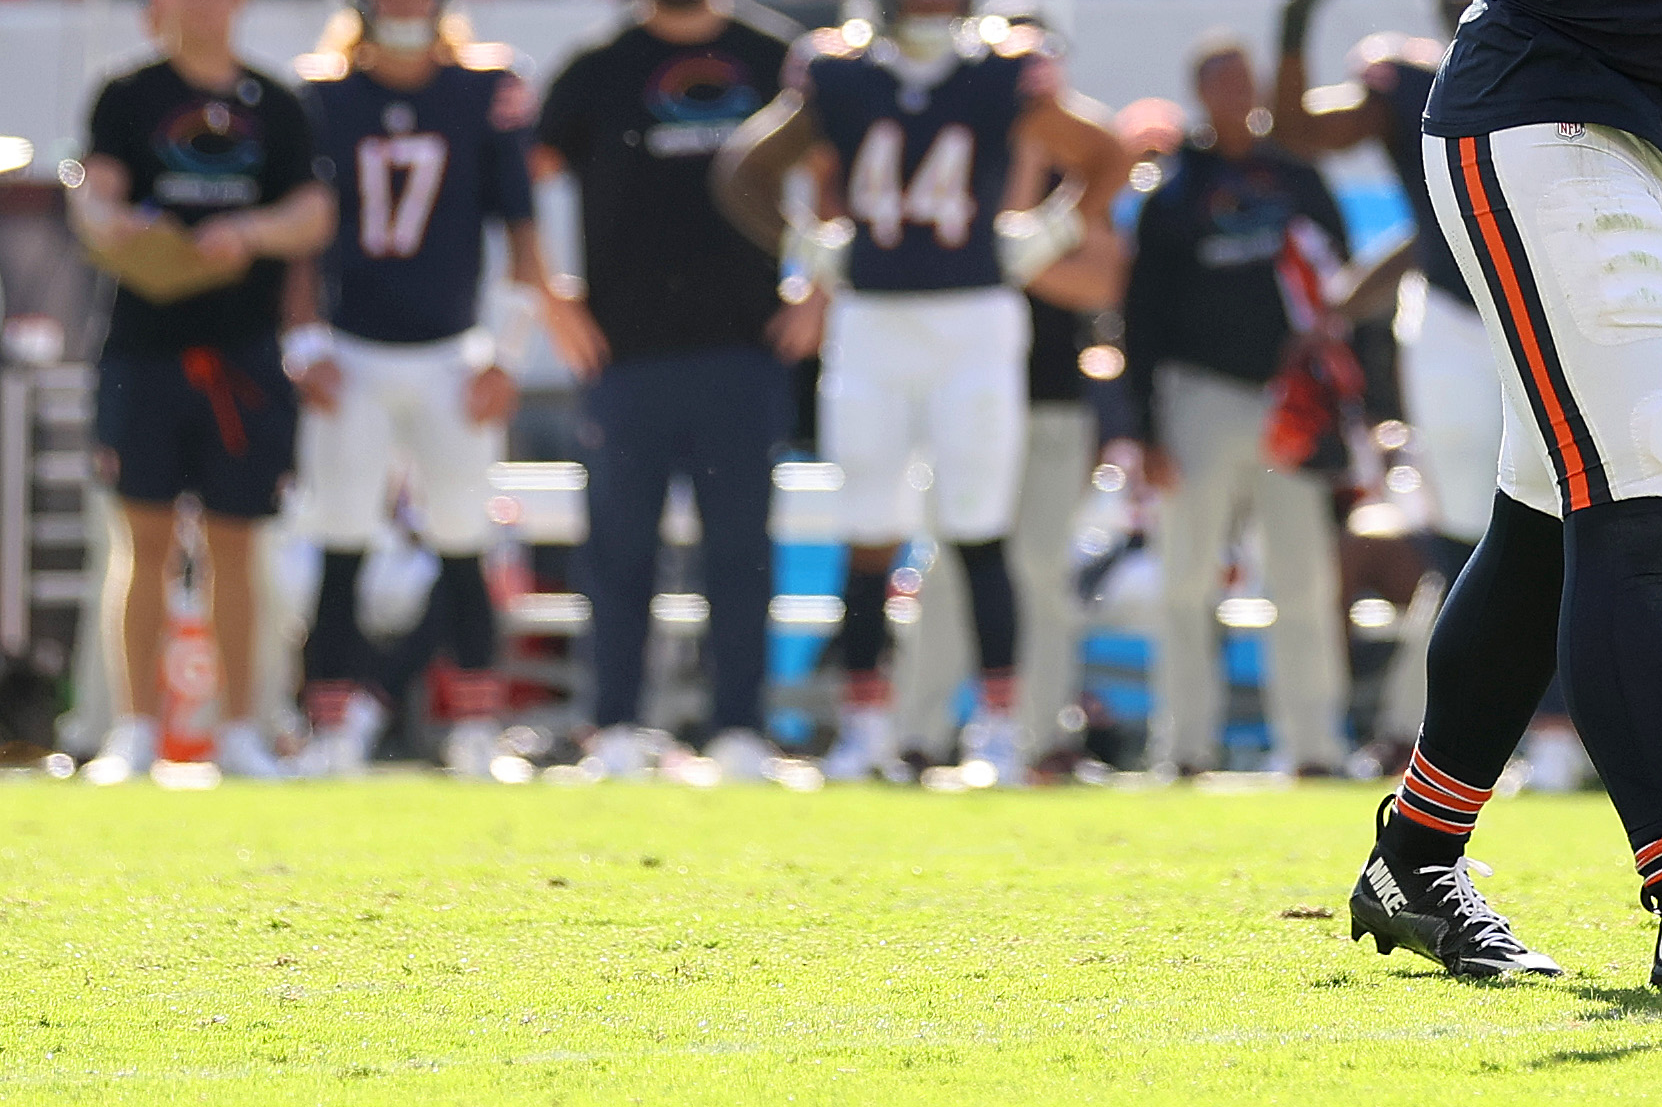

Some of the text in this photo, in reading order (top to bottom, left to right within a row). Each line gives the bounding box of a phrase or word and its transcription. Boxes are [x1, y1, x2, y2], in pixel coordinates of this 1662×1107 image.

[356, 132, 450, 259] 17
[848, 117, 977, 249] 44
[1365, 856, 1408, 917] NIKE
